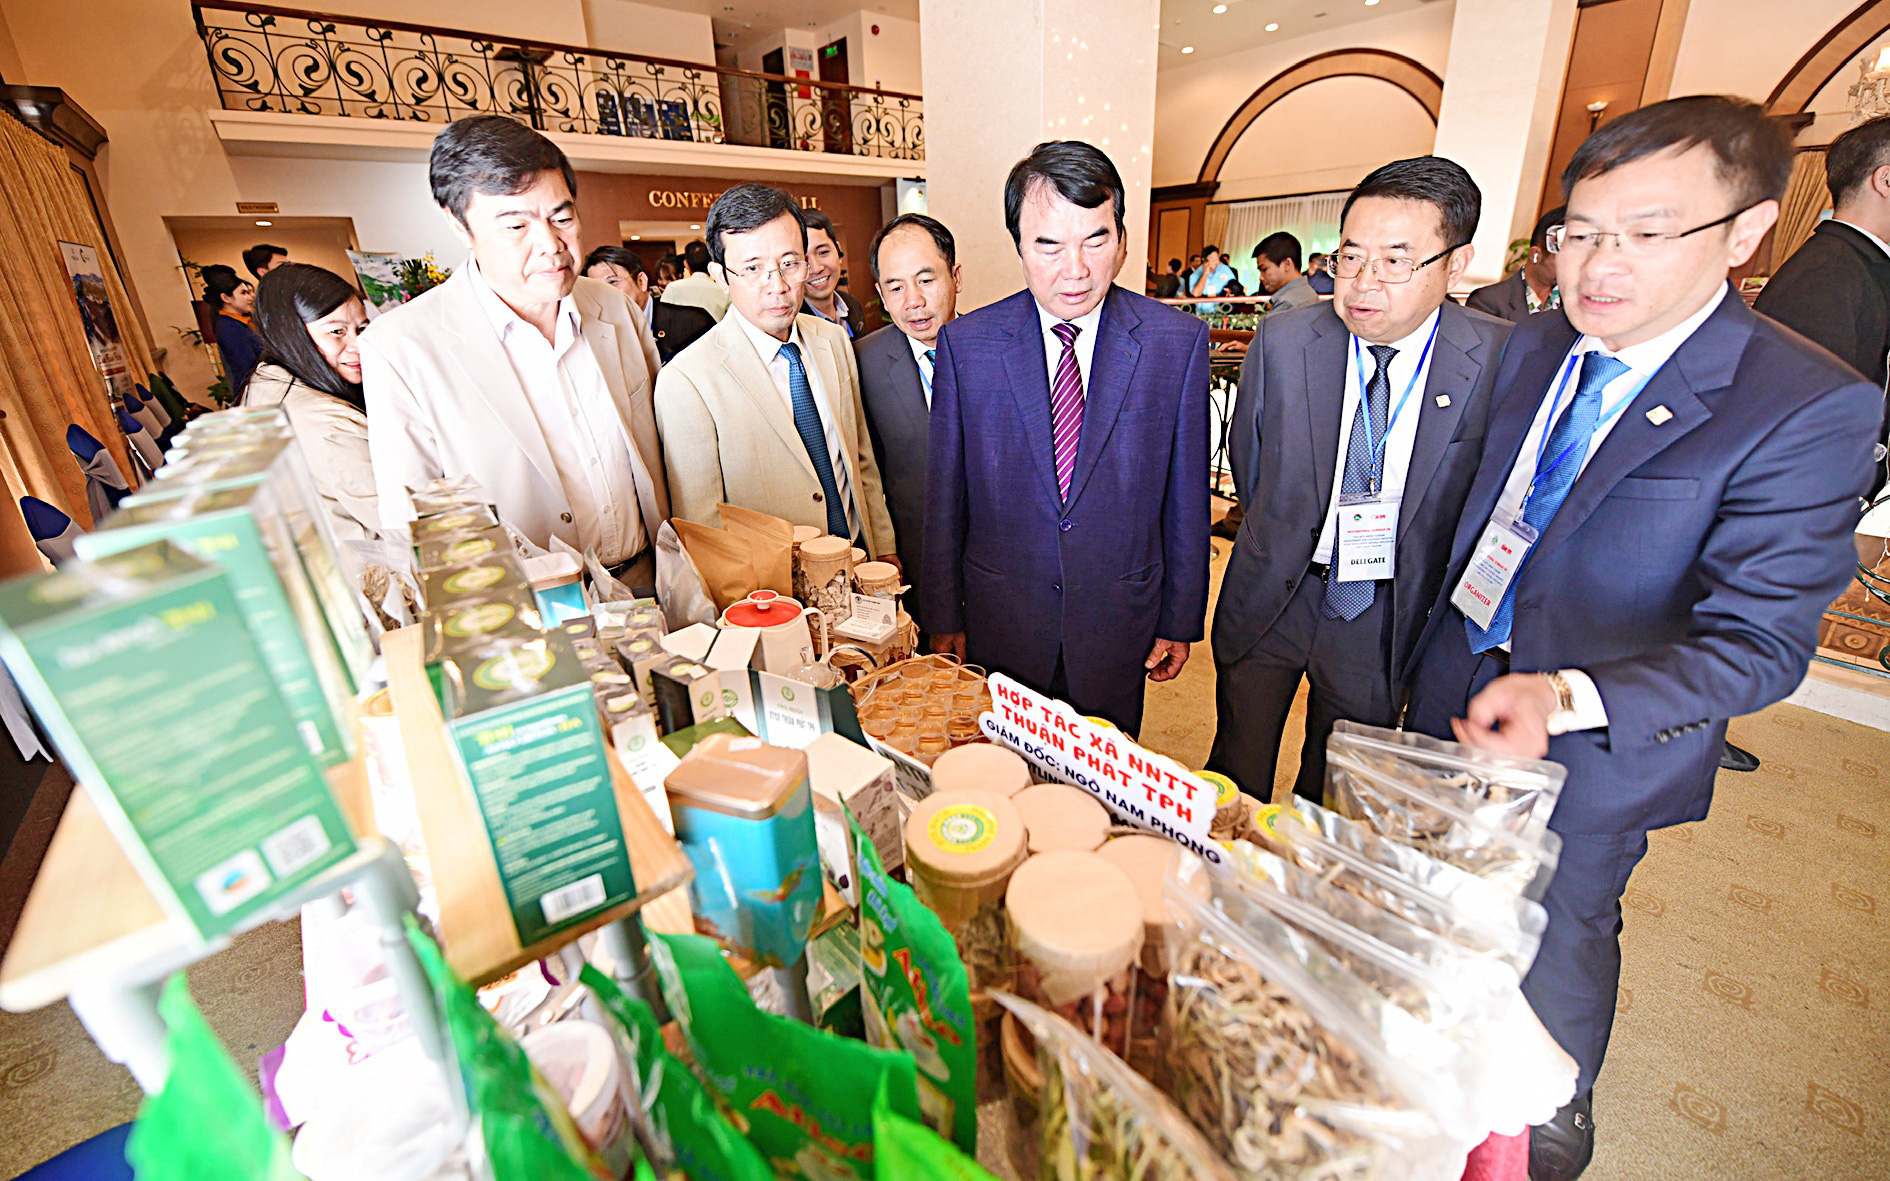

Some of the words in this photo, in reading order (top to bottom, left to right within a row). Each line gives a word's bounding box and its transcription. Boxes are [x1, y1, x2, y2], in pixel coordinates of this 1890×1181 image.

[1350, 556, 1386, 566] DELEGATE
[1463, 581, 1491, 607] ORGANIZER
[986, 719, 1020, 747] GIÁM
[1024, 741, 1061, 772] ĐỐC:
[1064, 765, 1101, 794] NGÔ
[1106, 789, 1145, 821] NAM
[1150, 815, 1222, 864] PHONG
[997, 683, 1033, 711] HỢP
[1040, 706, 1082, 740] TÁC
[1089, 732, 1120, 761] XÃ
[1128, 753, 1199, 801] NNTT
[1001, 704, 1065, 752] THUẬN
[1073, 745, 1133, 788] PHÁT
[1142, 782, 1193, 824] TPH
